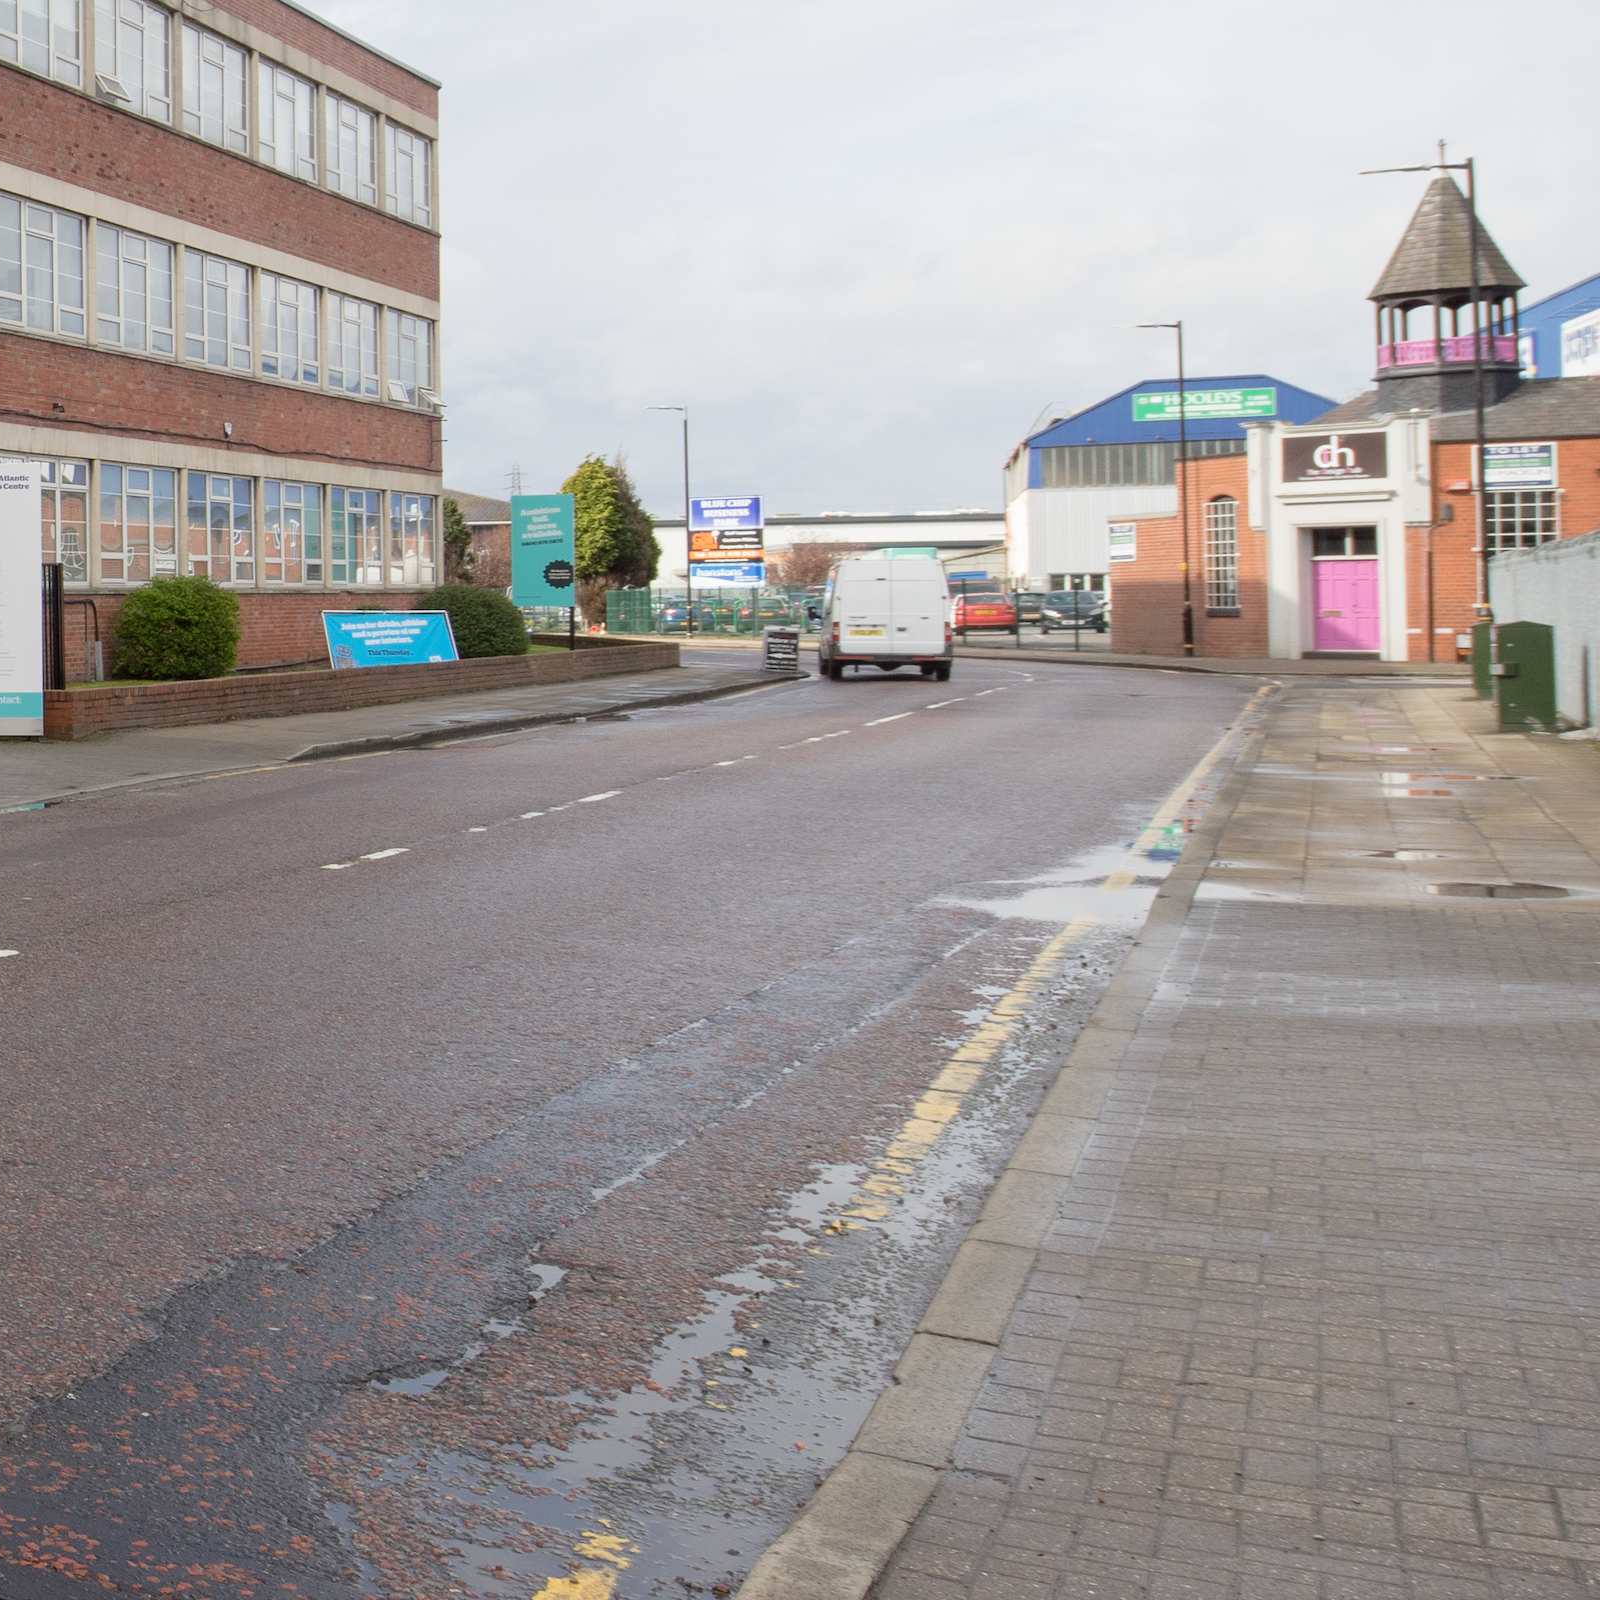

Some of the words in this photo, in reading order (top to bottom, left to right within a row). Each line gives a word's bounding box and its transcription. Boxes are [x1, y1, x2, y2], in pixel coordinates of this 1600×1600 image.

[1512, 446, 1541, 454] LET
[701, 500, 727, 508] BLUE
[727, 499, 752, 507] CHIP
[703, 508, 750, 517] BUSINESS
[526, 523, 557, 531] Spaces
[713, 518, 740, 527] PARK
[696, 568, 743, 577] hanstons
